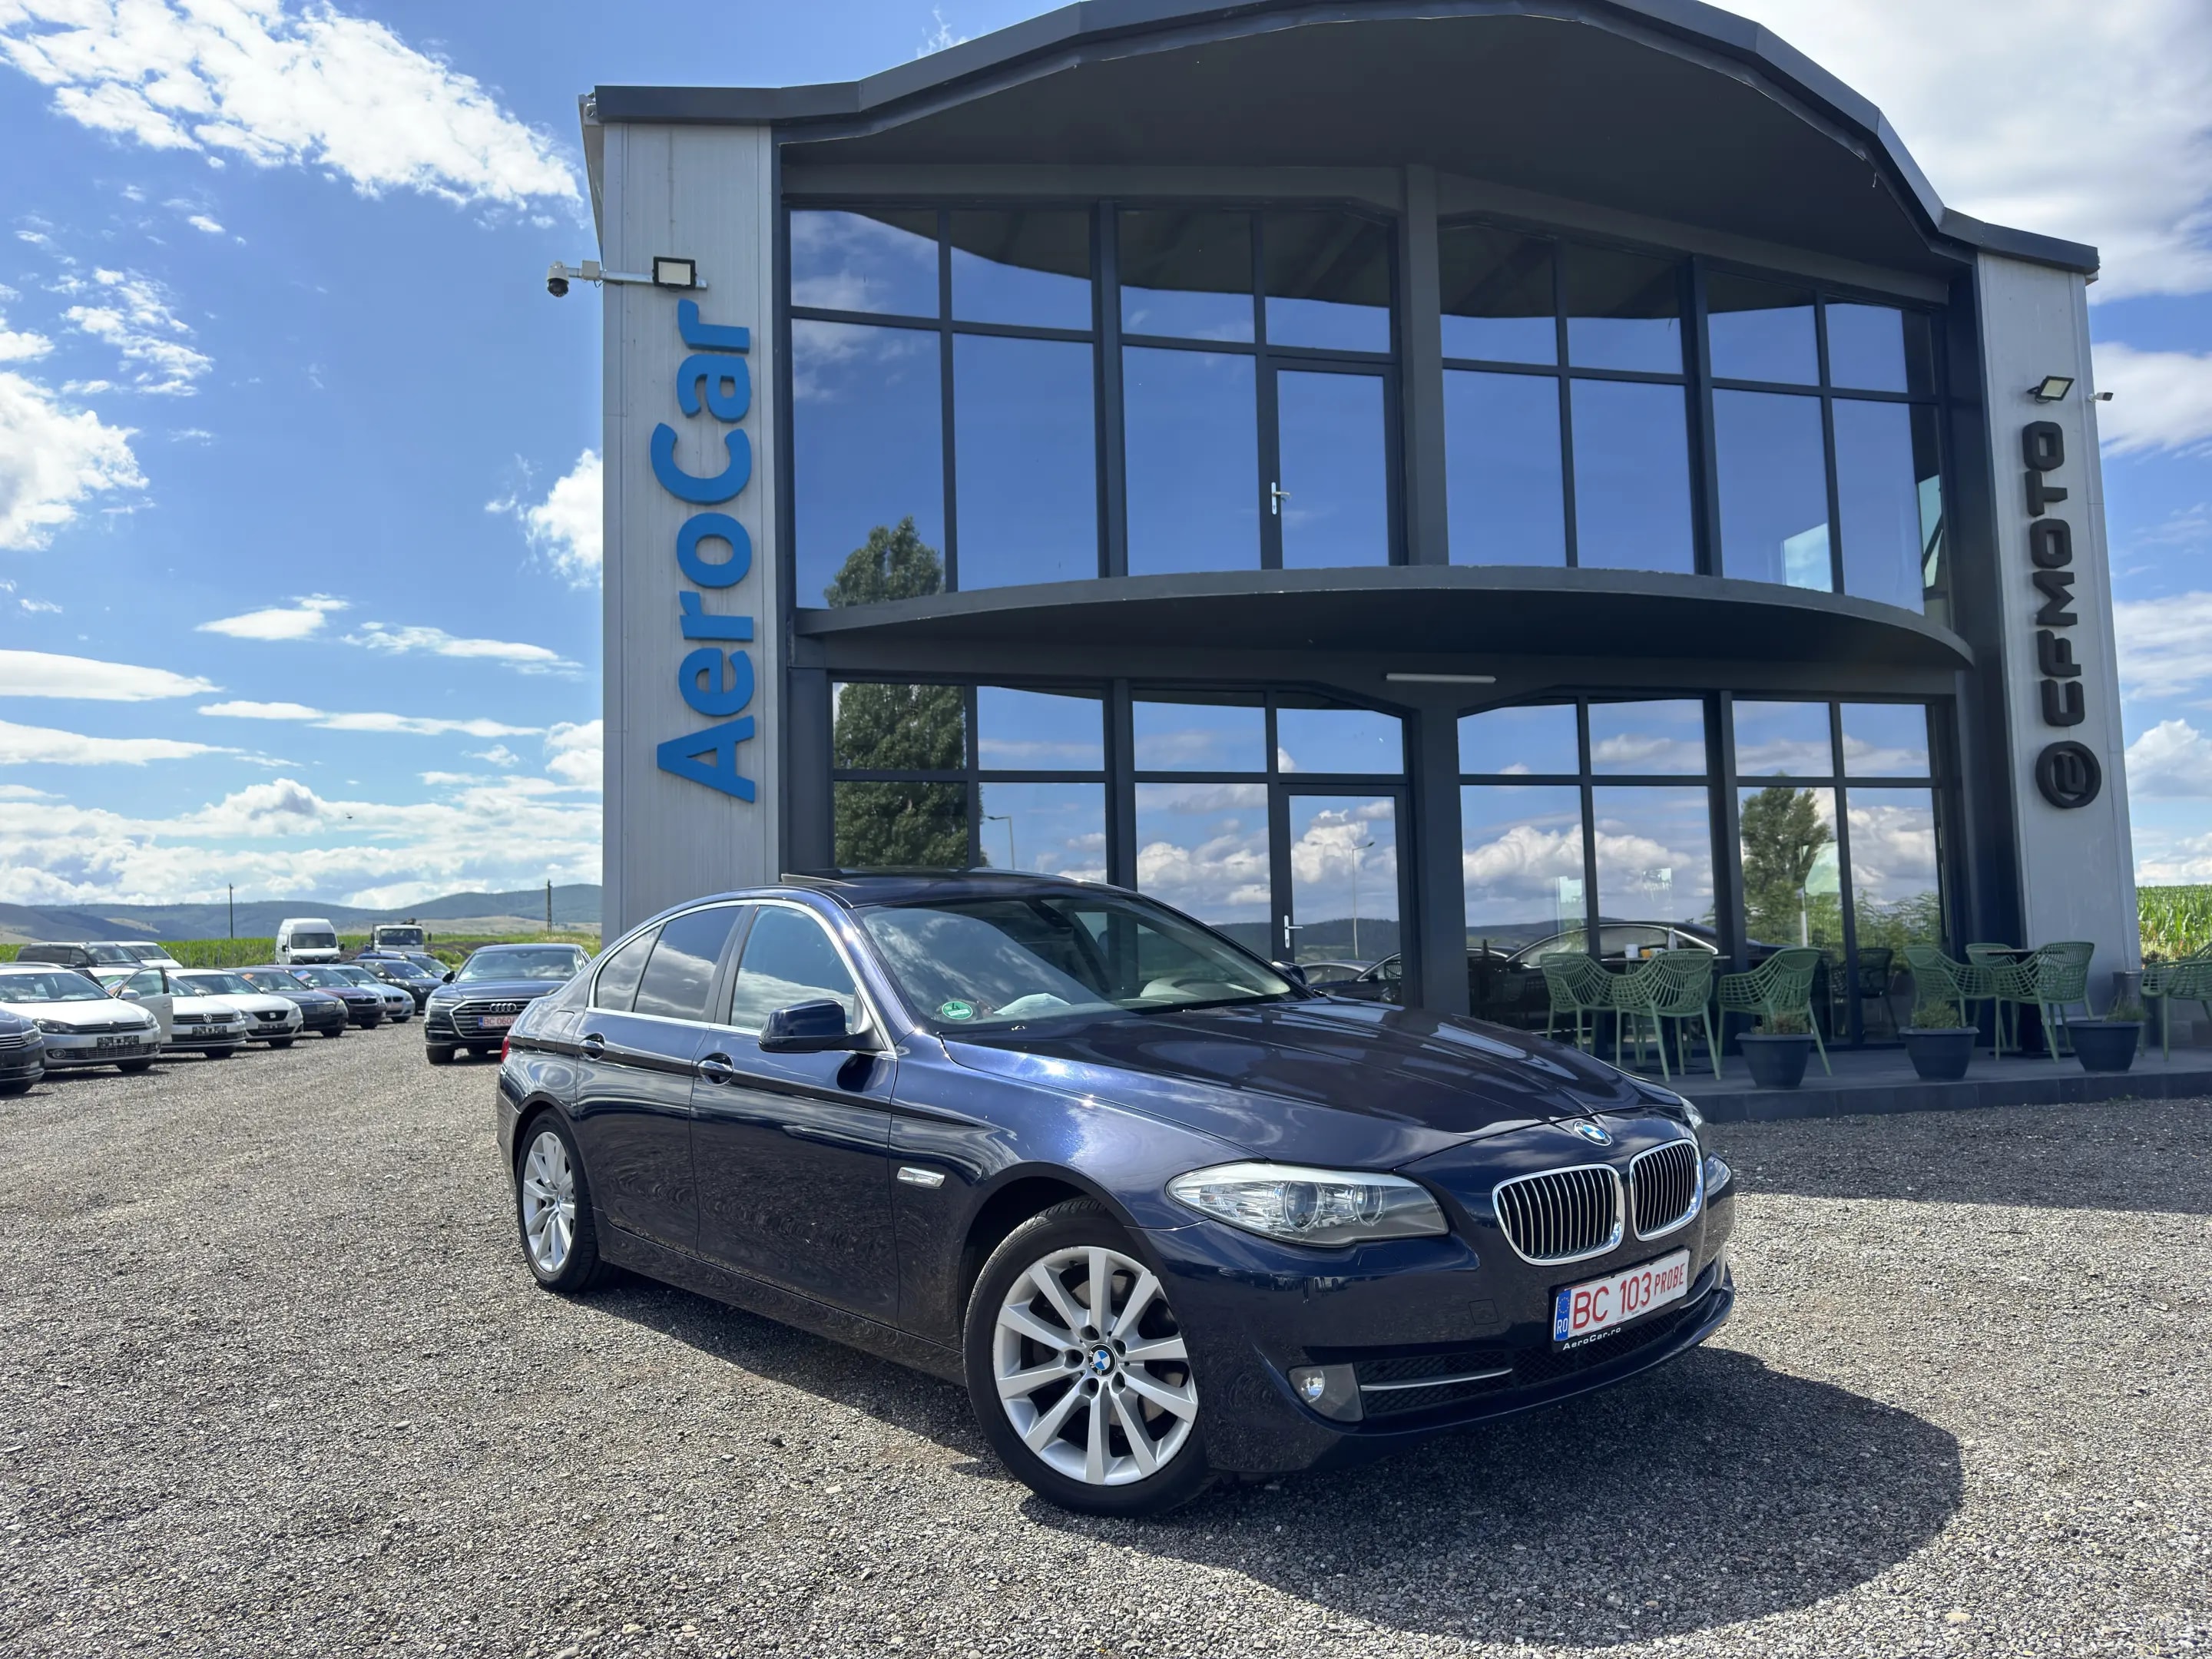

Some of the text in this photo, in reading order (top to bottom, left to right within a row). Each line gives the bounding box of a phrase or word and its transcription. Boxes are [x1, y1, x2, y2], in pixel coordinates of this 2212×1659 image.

[650, 298, 756, 804] AeroCar
[2022, 420, 2086, 728] CFMOTO
[483, 1017, 495, 1025] BC
[1572, 1263, 1685, 1330] BC 103 PROBE
[1556, 1317, 1568, 1335] RO
[1562, 1327, 1621, 1351] AeroCar.ro
